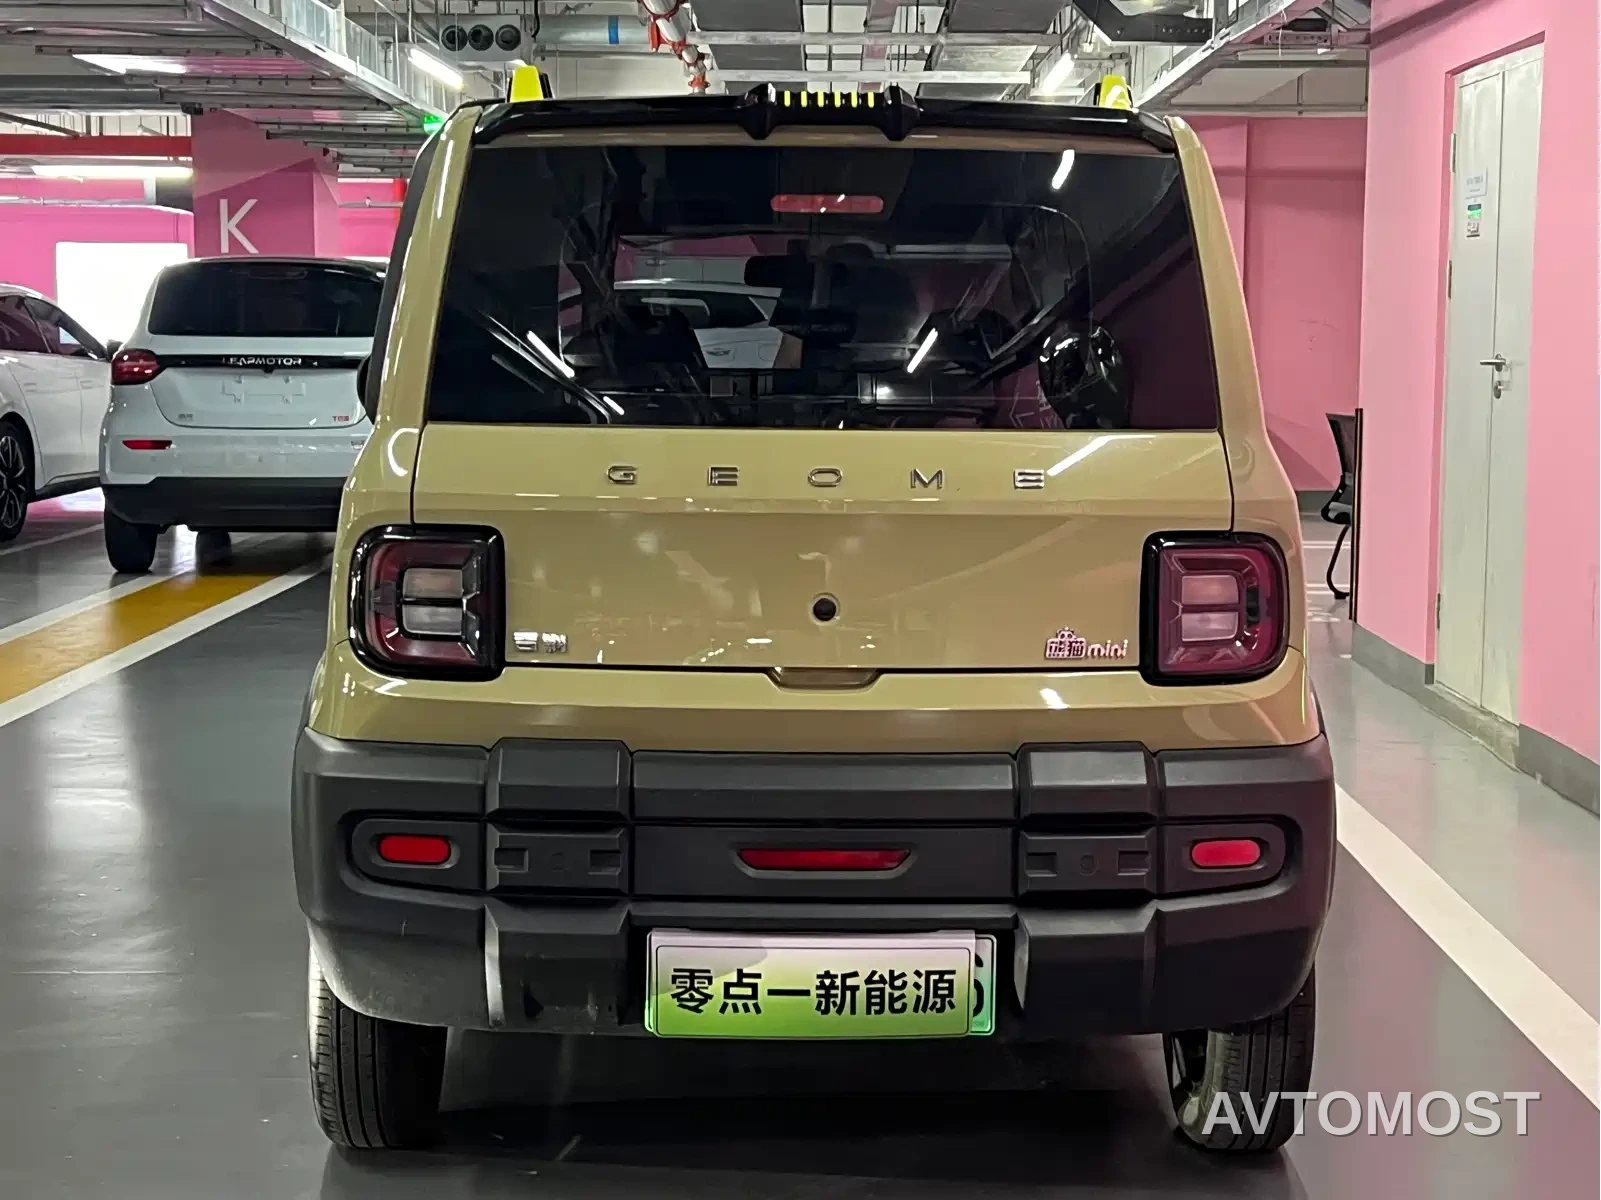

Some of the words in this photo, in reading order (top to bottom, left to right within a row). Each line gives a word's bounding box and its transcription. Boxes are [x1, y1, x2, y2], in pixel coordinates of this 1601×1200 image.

[220, 199, 259, 254] K
[606, 465, 1045, 490] GEOME
[670, 968, 957, 1016] 零点一新能源
